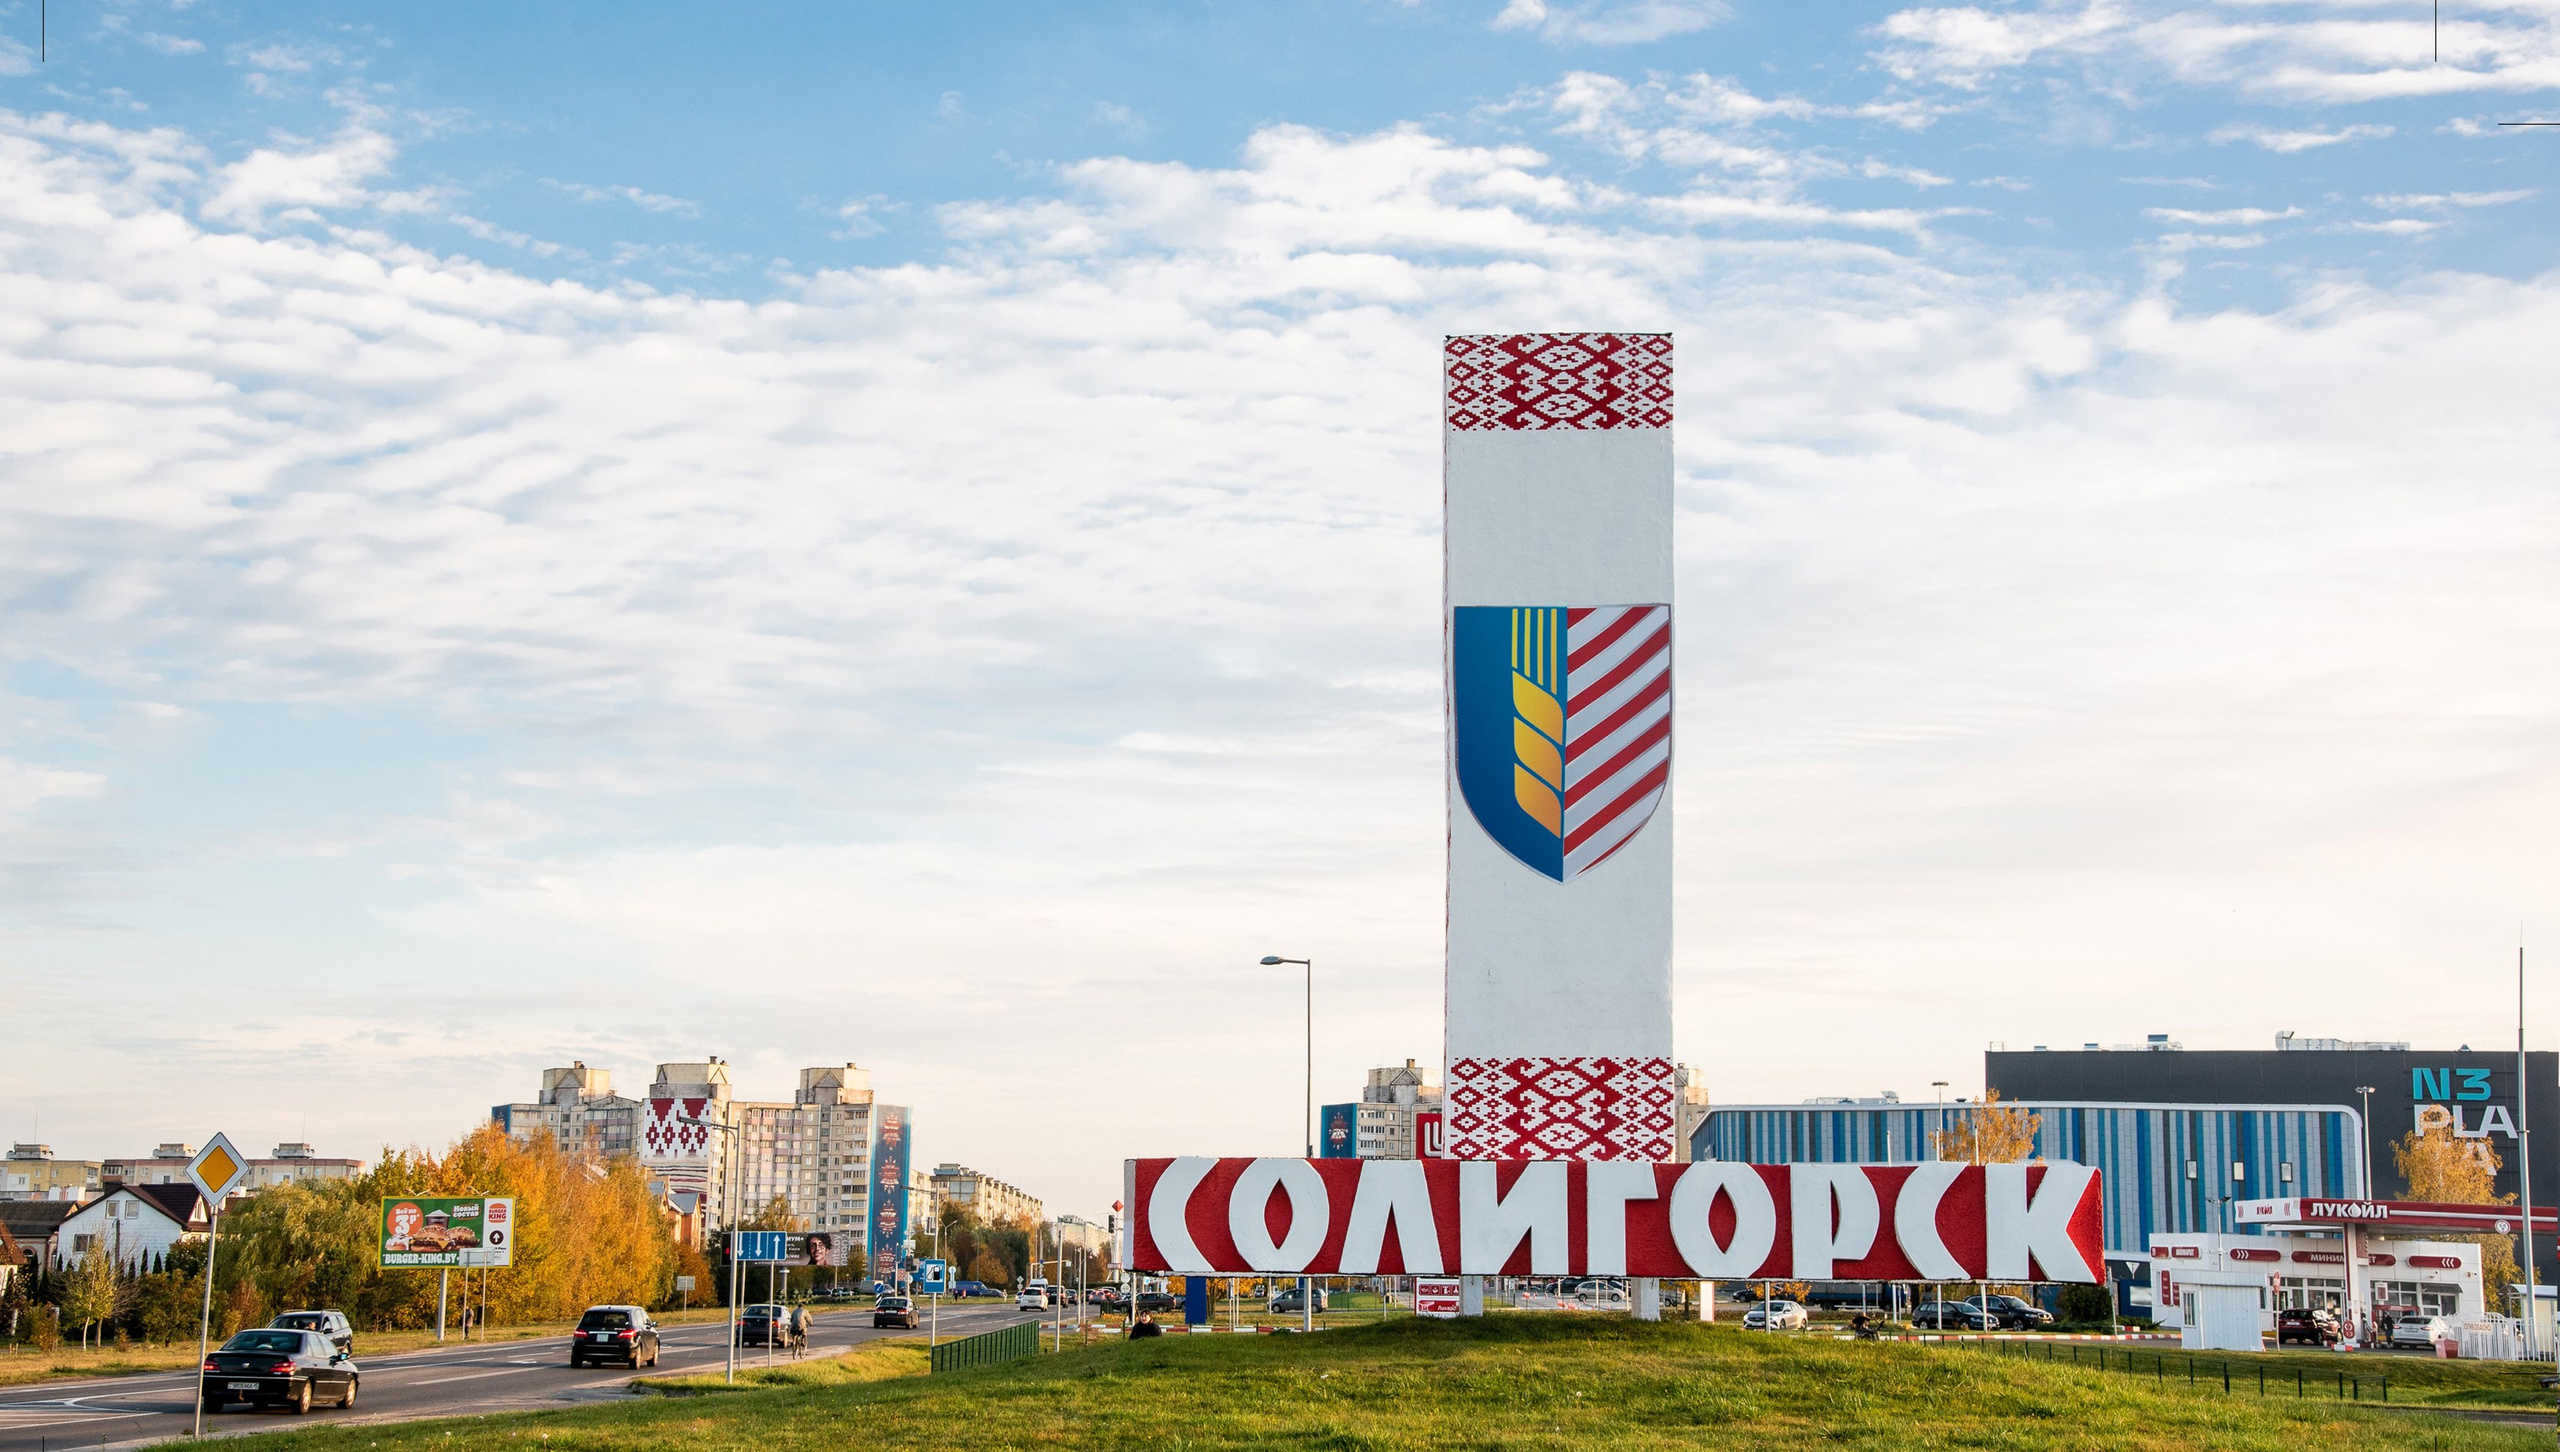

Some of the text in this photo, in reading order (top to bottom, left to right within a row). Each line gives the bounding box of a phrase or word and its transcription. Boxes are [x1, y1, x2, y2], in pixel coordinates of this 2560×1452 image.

[2412, 1068, 2491, 1100] N3
[2414, 1104, 2518, 1139] PLA
[453, 1203, 480, 1212] Новый
[1148, 1156, 2097, 1284] СОЛИГОРСК
